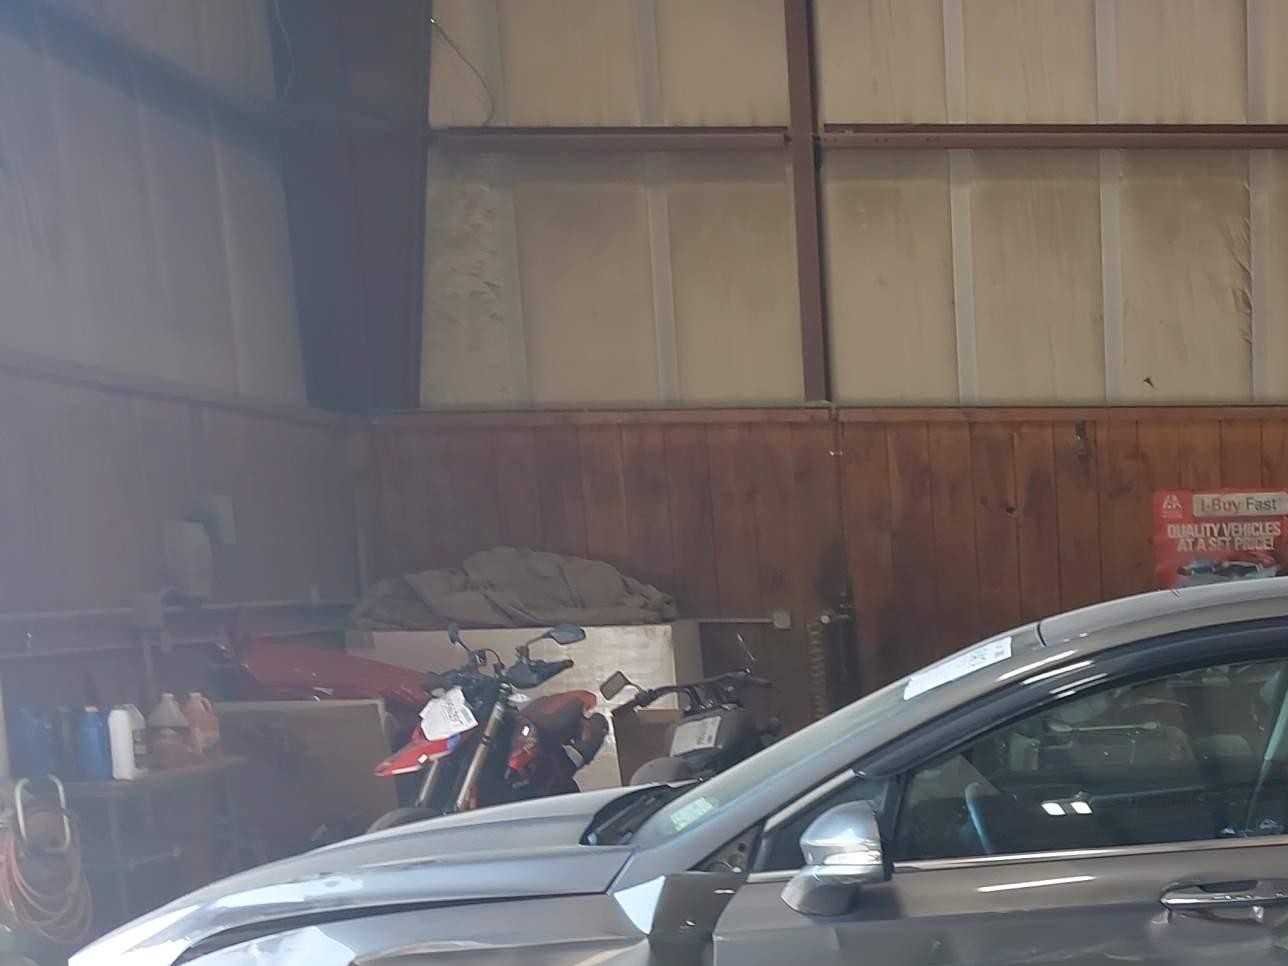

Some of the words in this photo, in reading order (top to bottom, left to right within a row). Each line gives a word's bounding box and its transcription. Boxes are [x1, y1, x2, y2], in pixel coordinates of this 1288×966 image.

[1201, 497, 1241, 513] I-Buy
[1246, 496, 1278, 512] Fast
[1167, 522, 1220, 539] QUALITY
[1222, 521, 1281, 537] VEHICLES
[1177, 538, 1195, 552] AT
[1197, 537, 1206, 552] A
[1208, 536, 1232, 552] SET
[1234, 535, 1275, 551] PRICE!
